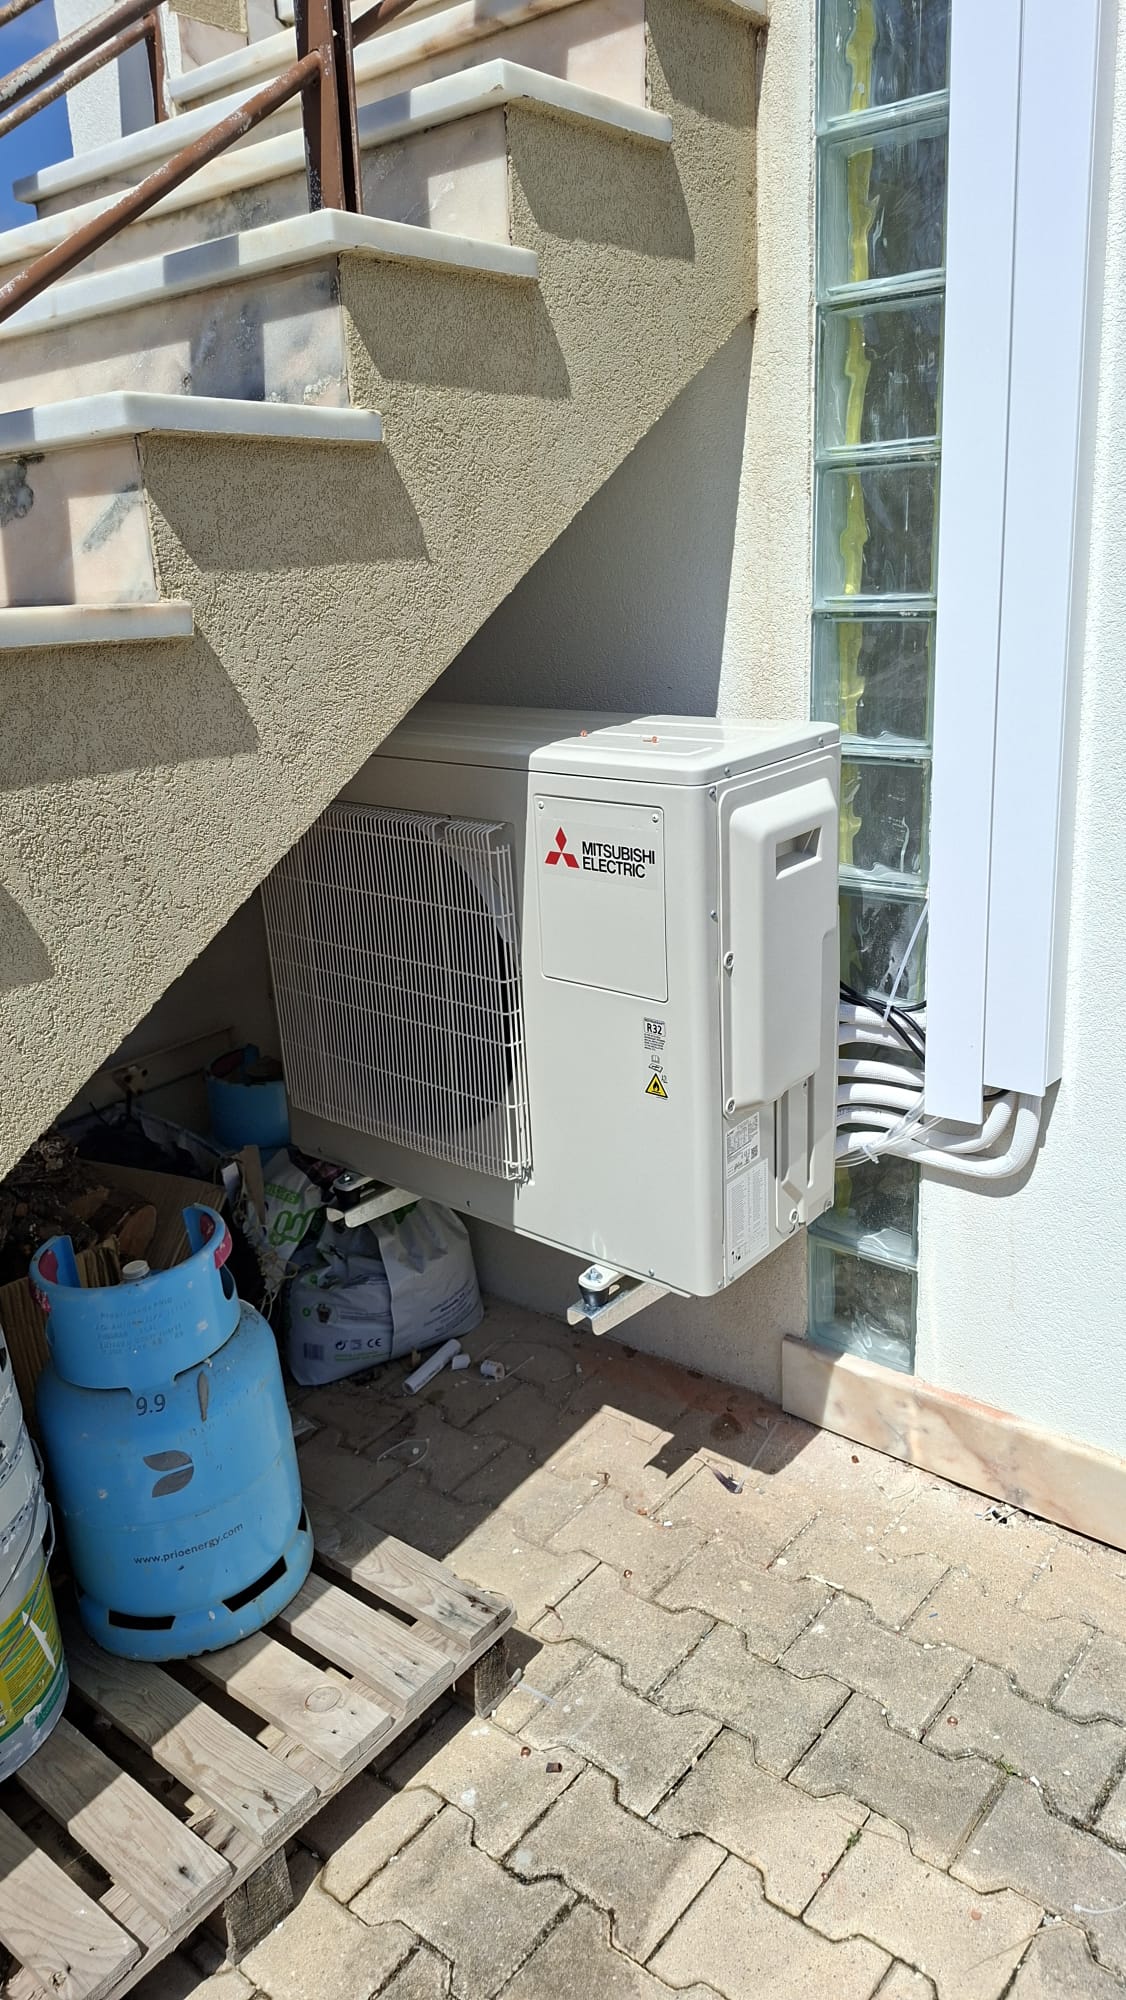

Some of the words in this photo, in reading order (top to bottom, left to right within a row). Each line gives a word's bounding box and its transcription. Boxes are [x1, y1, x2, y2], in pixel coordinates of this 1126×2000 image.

[582, 841, 656, 865] MITSUBISHI
[582, 856, 646, 878] ELECTRIC
[647, 1022, 662, 1035] R32
[135, 1393, 166, 1416] 9.9
[133, 1523, 244, 1565] www.prioenergy.com
